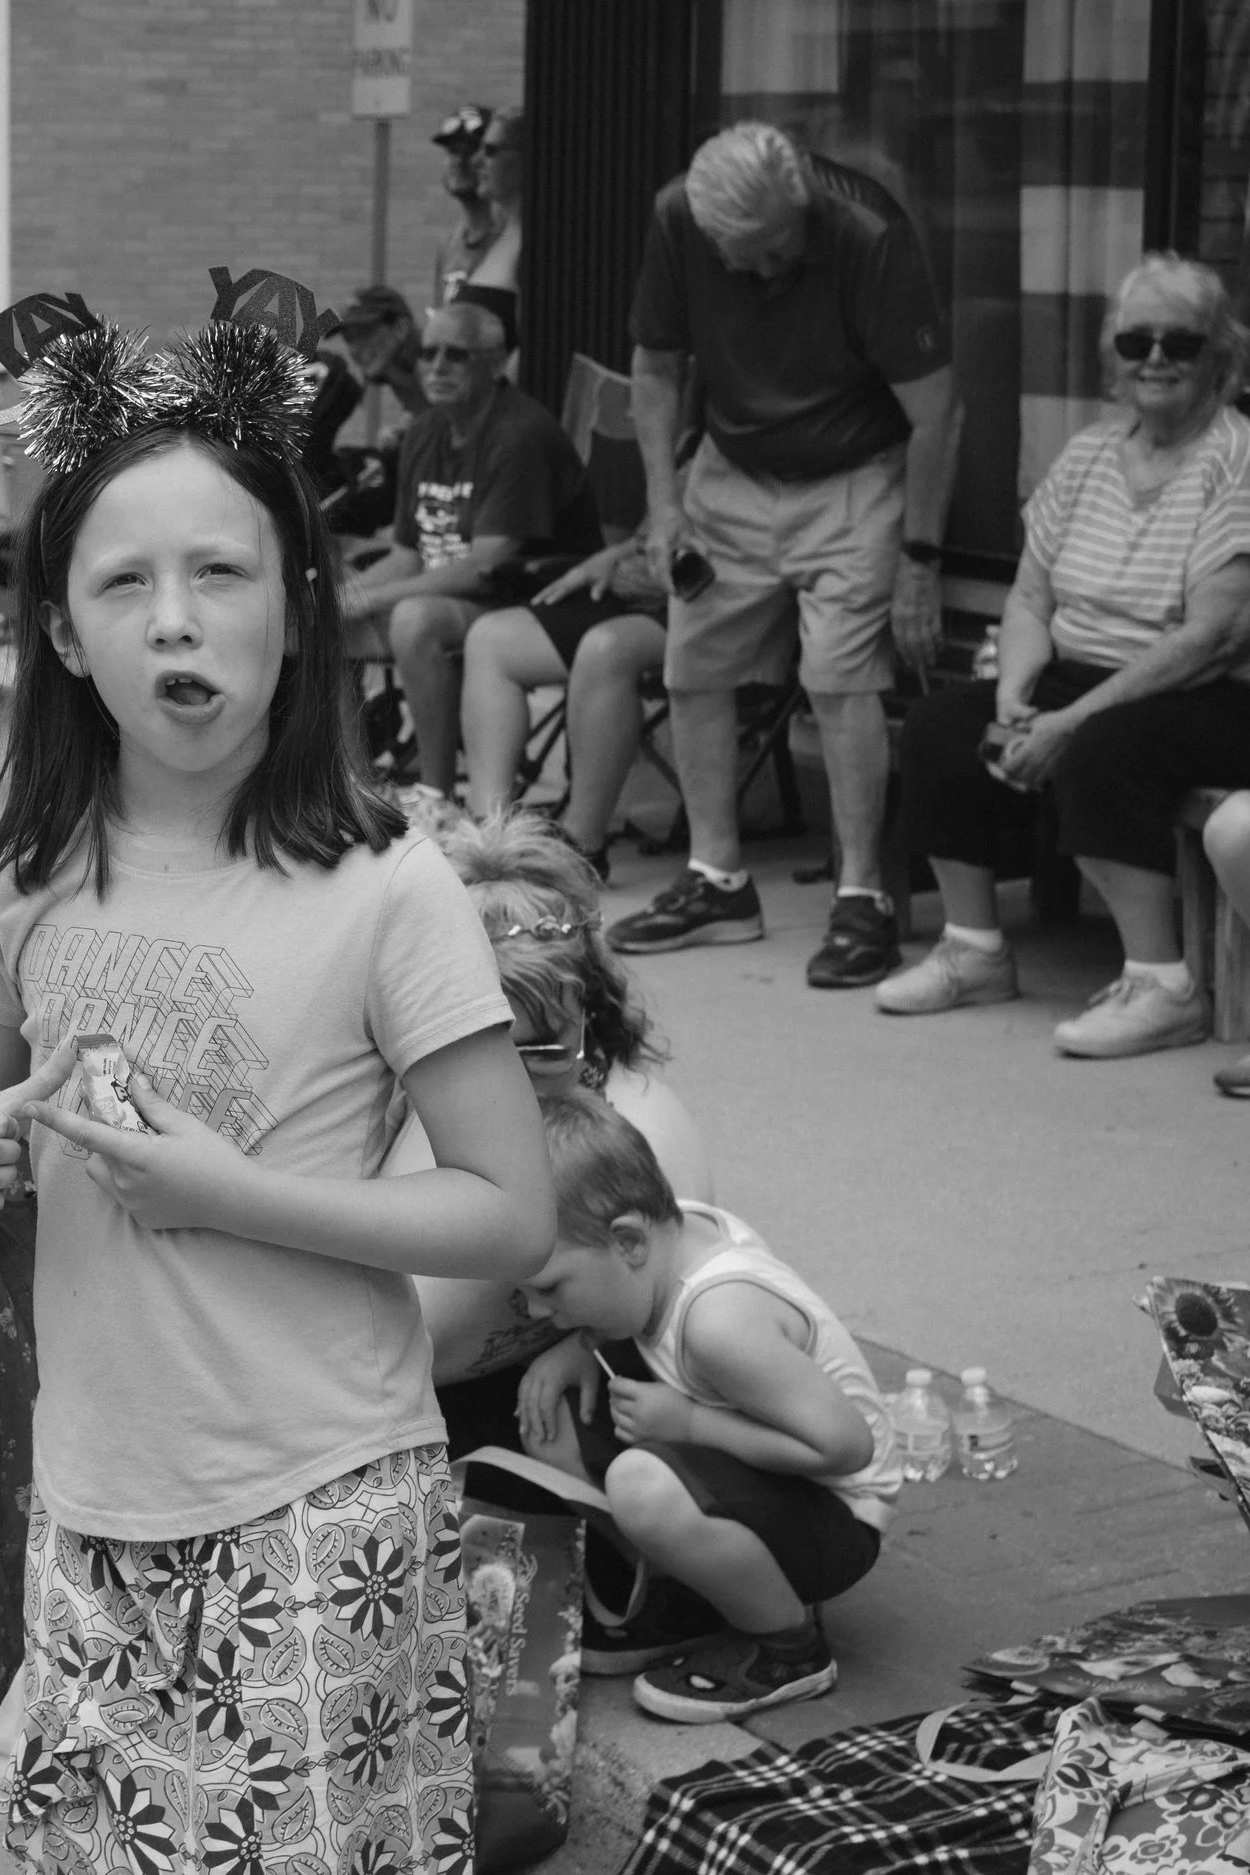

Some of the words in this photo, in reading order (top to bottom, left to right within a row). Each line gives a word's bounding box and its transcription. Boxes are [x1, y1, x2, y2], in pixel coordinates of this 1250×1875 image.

[207, 266, 342, 361] YAY
[23, 924, 254, 1005] DANCE
[511, 1592, 530, 1634] Seed
[505, 1637, 527, 1696] Savers
